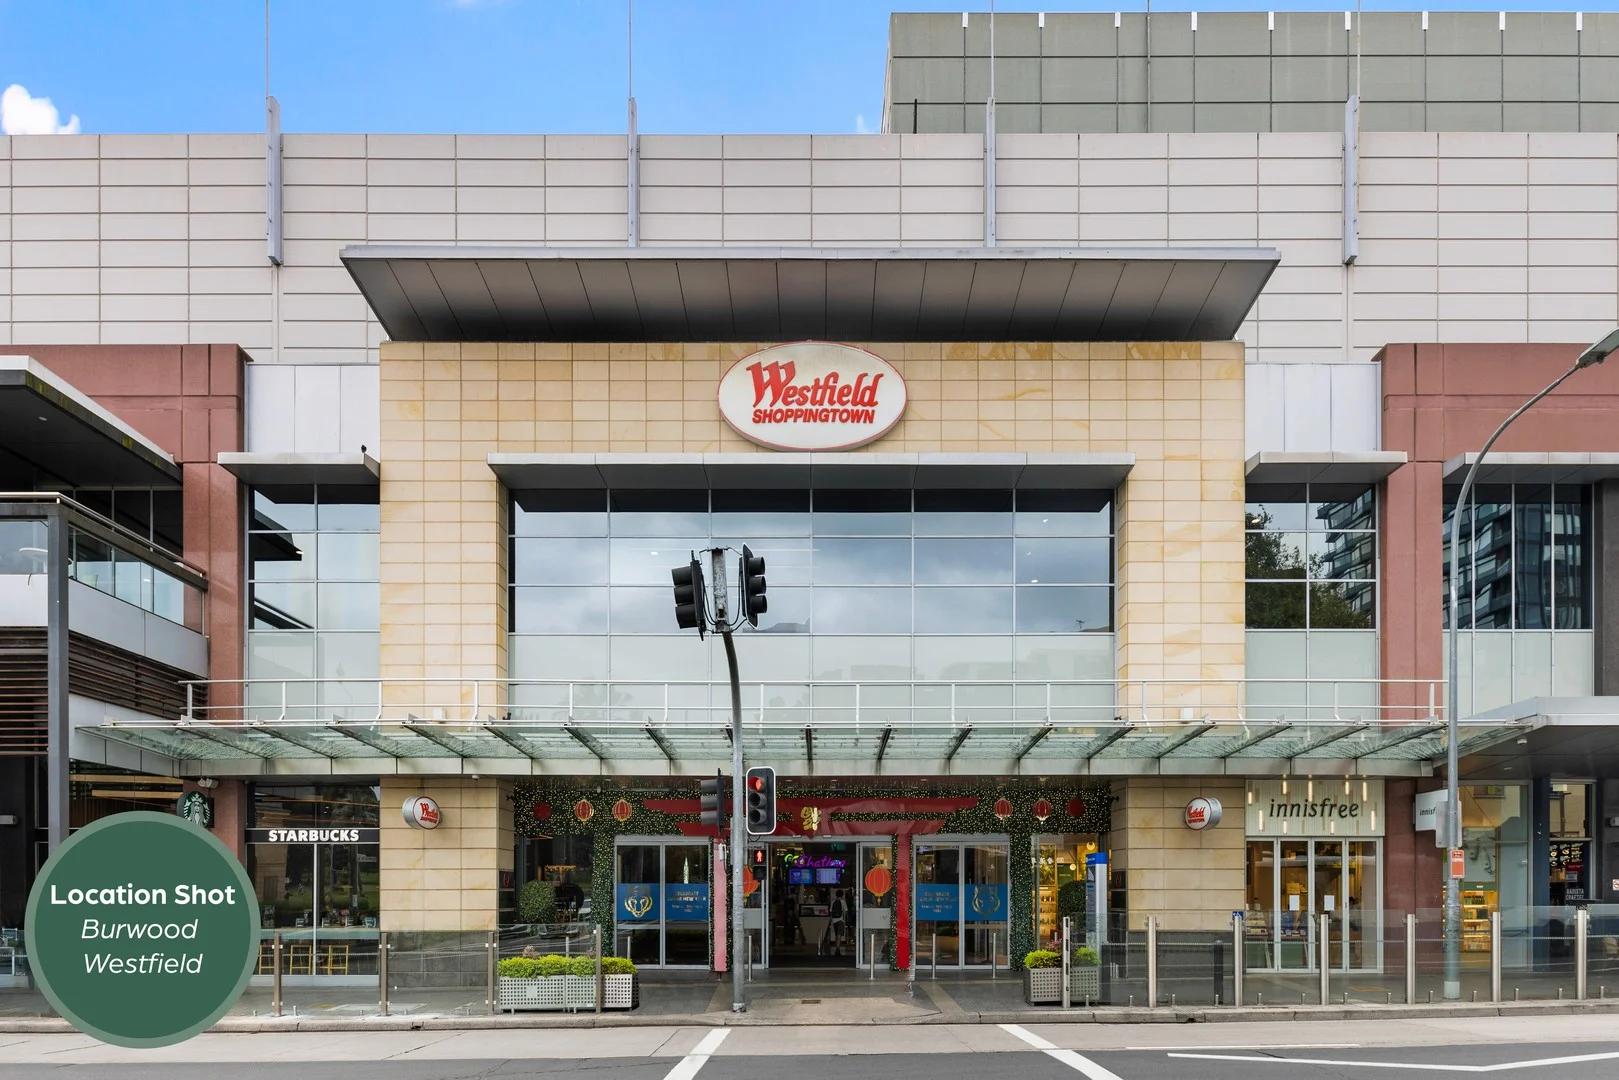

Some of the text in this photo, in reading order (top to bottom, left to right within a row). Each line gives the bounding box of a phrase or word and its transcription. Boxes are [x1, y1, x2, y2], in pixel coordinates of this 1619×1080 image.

[746, 360, 884, 408] Westfield
[752, 408, 875, 424] SHOPPINGTOWN
[1269, 798, 1359, 818] innisfree
[1419, 807, 1436, 816] innisf
[268, 829, 360, 842] STARBUCKS
[796, 855, 846, 867] Chatime
